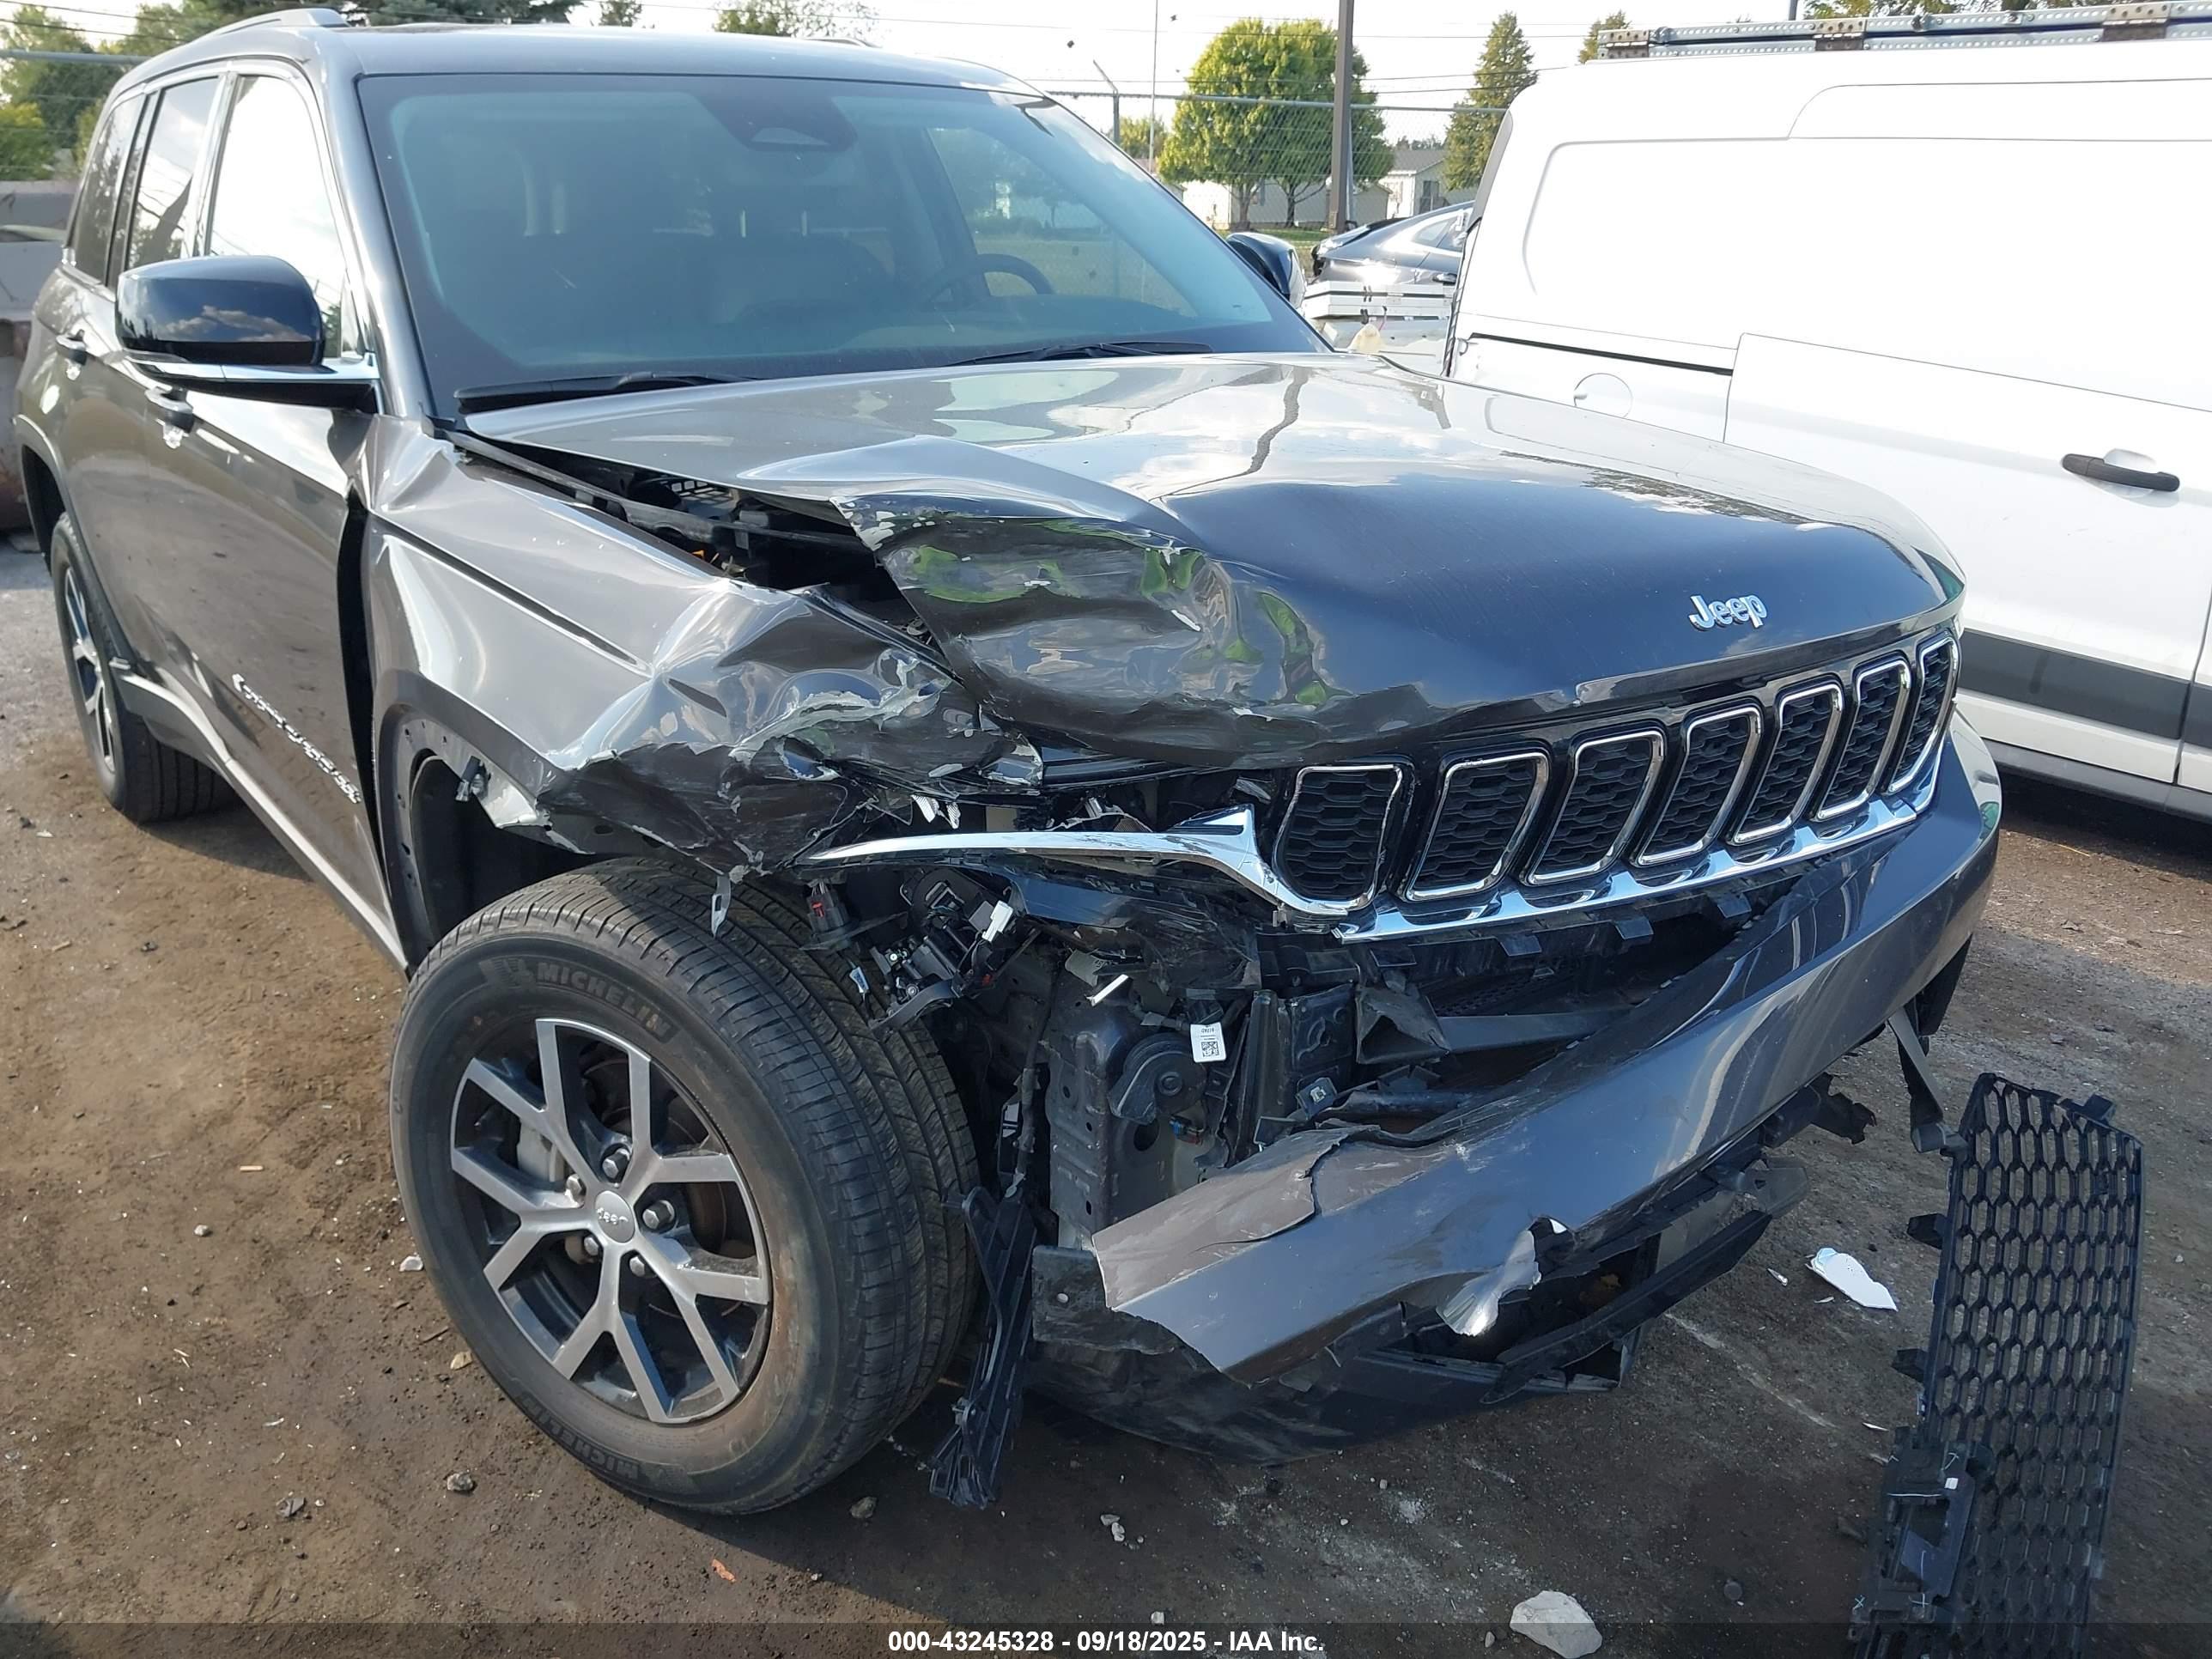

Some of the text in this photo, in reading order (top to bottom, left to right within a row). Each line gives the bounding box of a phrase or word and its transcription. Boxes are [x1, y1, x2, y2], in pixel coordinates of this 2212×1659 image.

[1688, 594, 1767, 629] Jeep
[537, 961, 672, 1039] MICHELIN
[520, 1391, 640, 1480] MICHELIN
